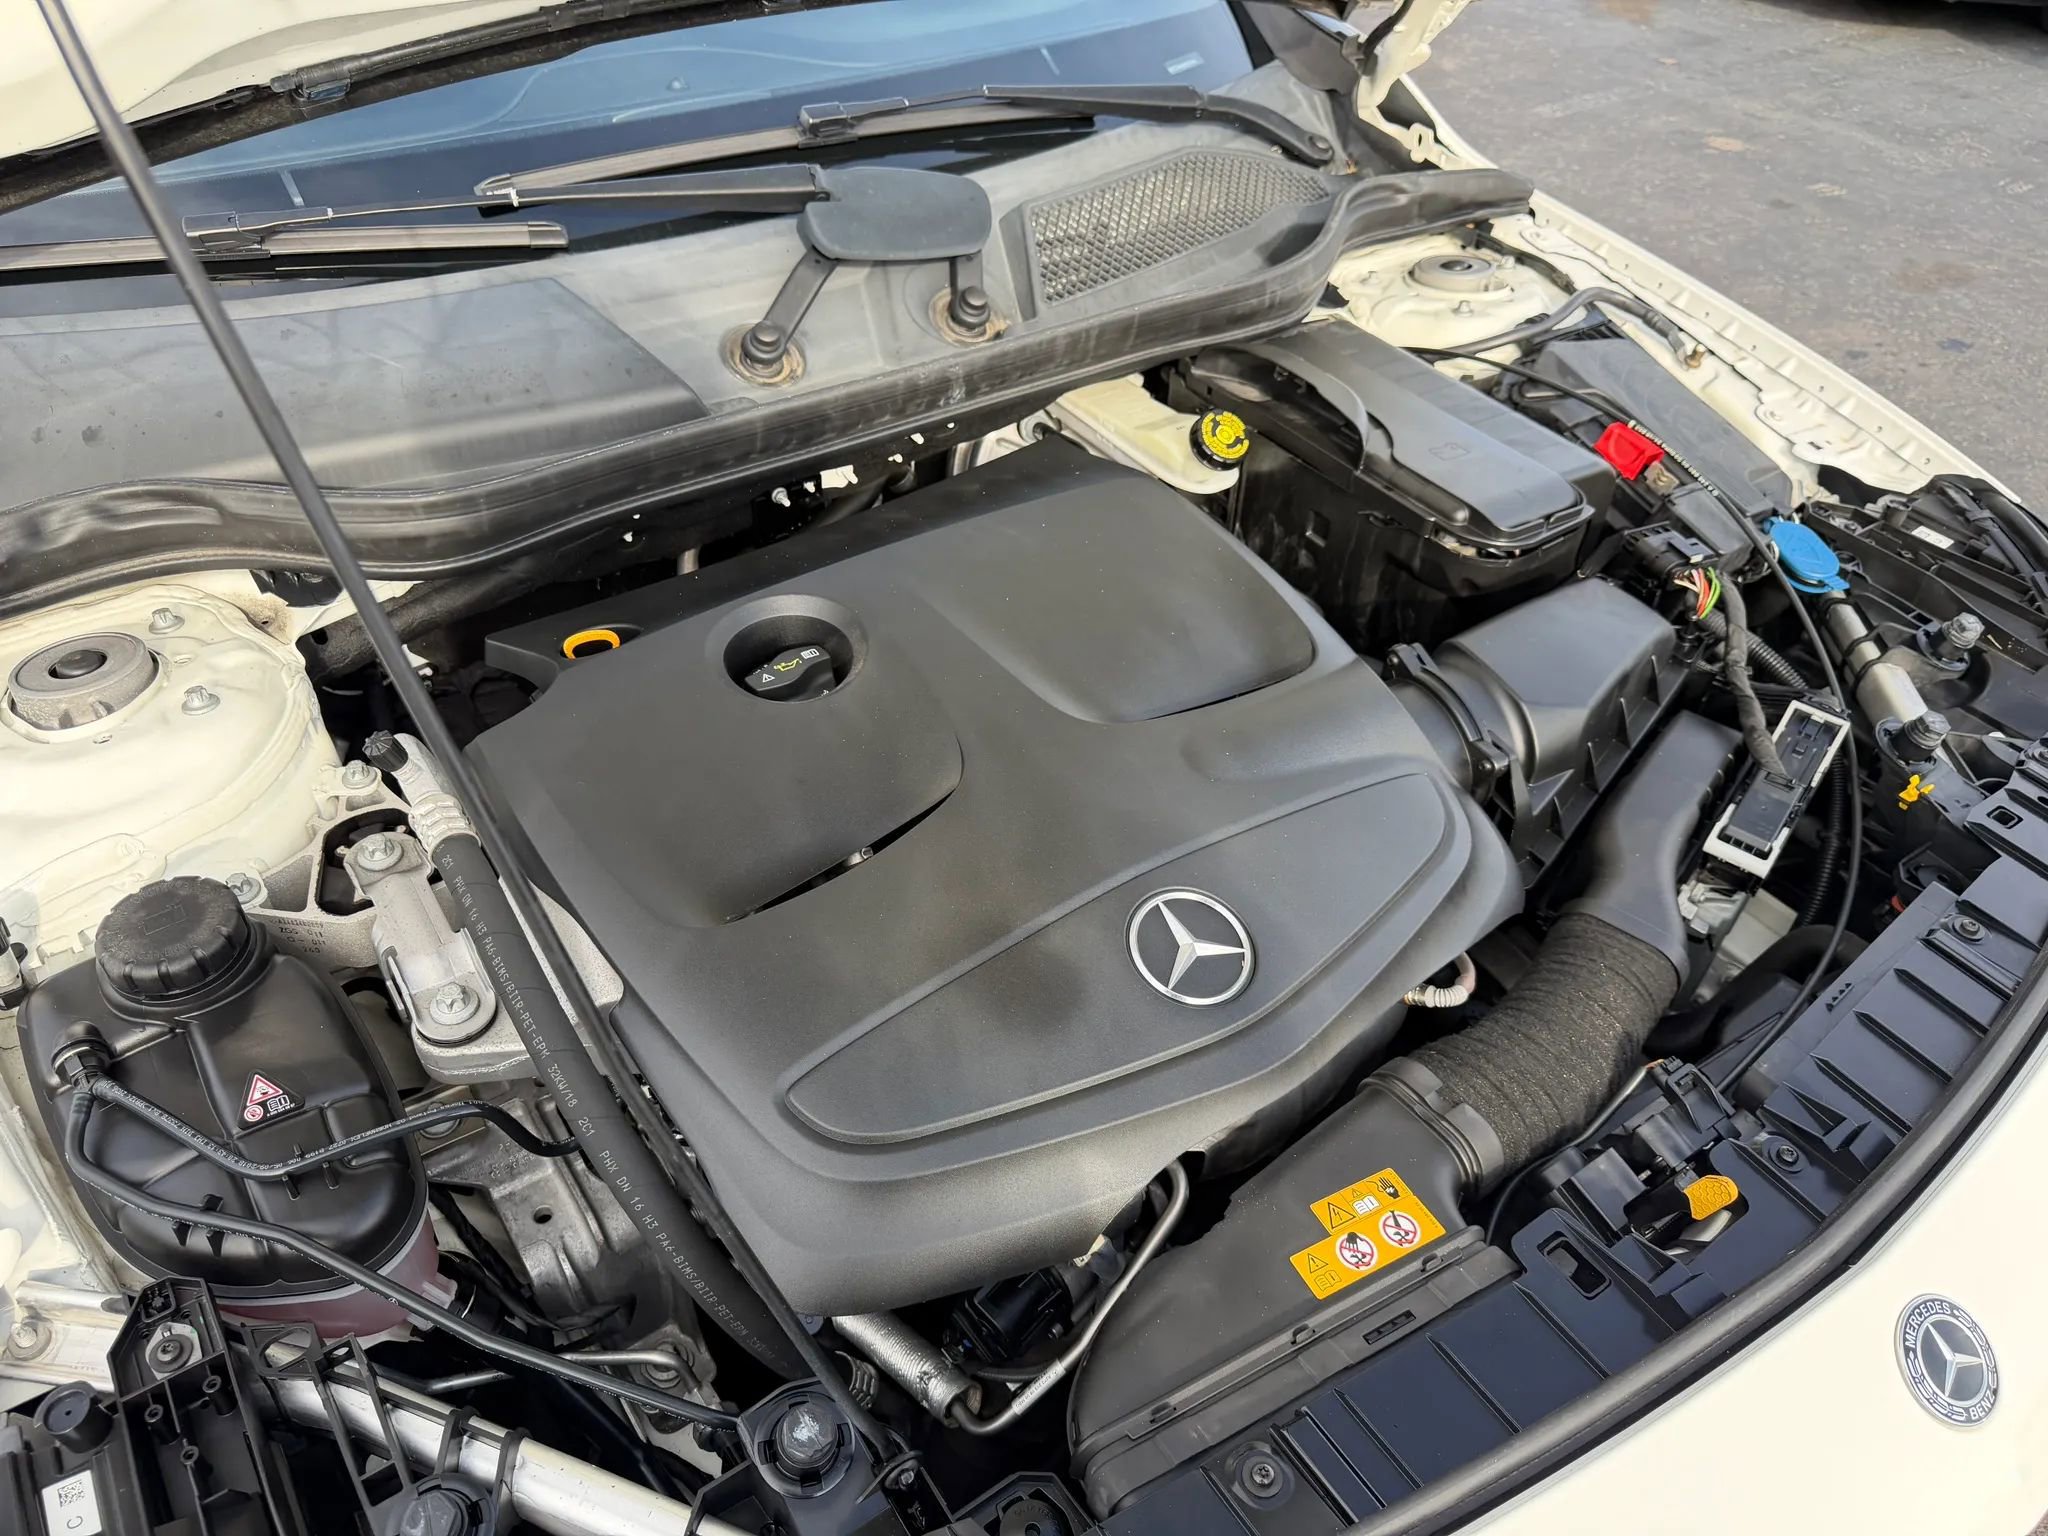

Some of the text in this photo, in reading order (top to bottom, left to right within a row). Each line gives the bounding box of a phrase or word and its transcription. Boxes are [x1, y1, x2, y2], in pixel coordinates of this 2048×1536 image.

[453, 875, 466, 894] PHX
[468, 908, 479, 921] 16
[475, 921, 488, 937] H3
[578, 1116, 596, 1138] 2C1
[600, 1150, 620, 1173] PHX
[616, 1176, 632, 1192] DN
[630, 1197, 645, 1211] 16
[642, 1214, 659, 1230] H3
[1904, 1301, 1951, 1349] MERCEDES
[1969, 1390, 1995, 1420] BENZ
